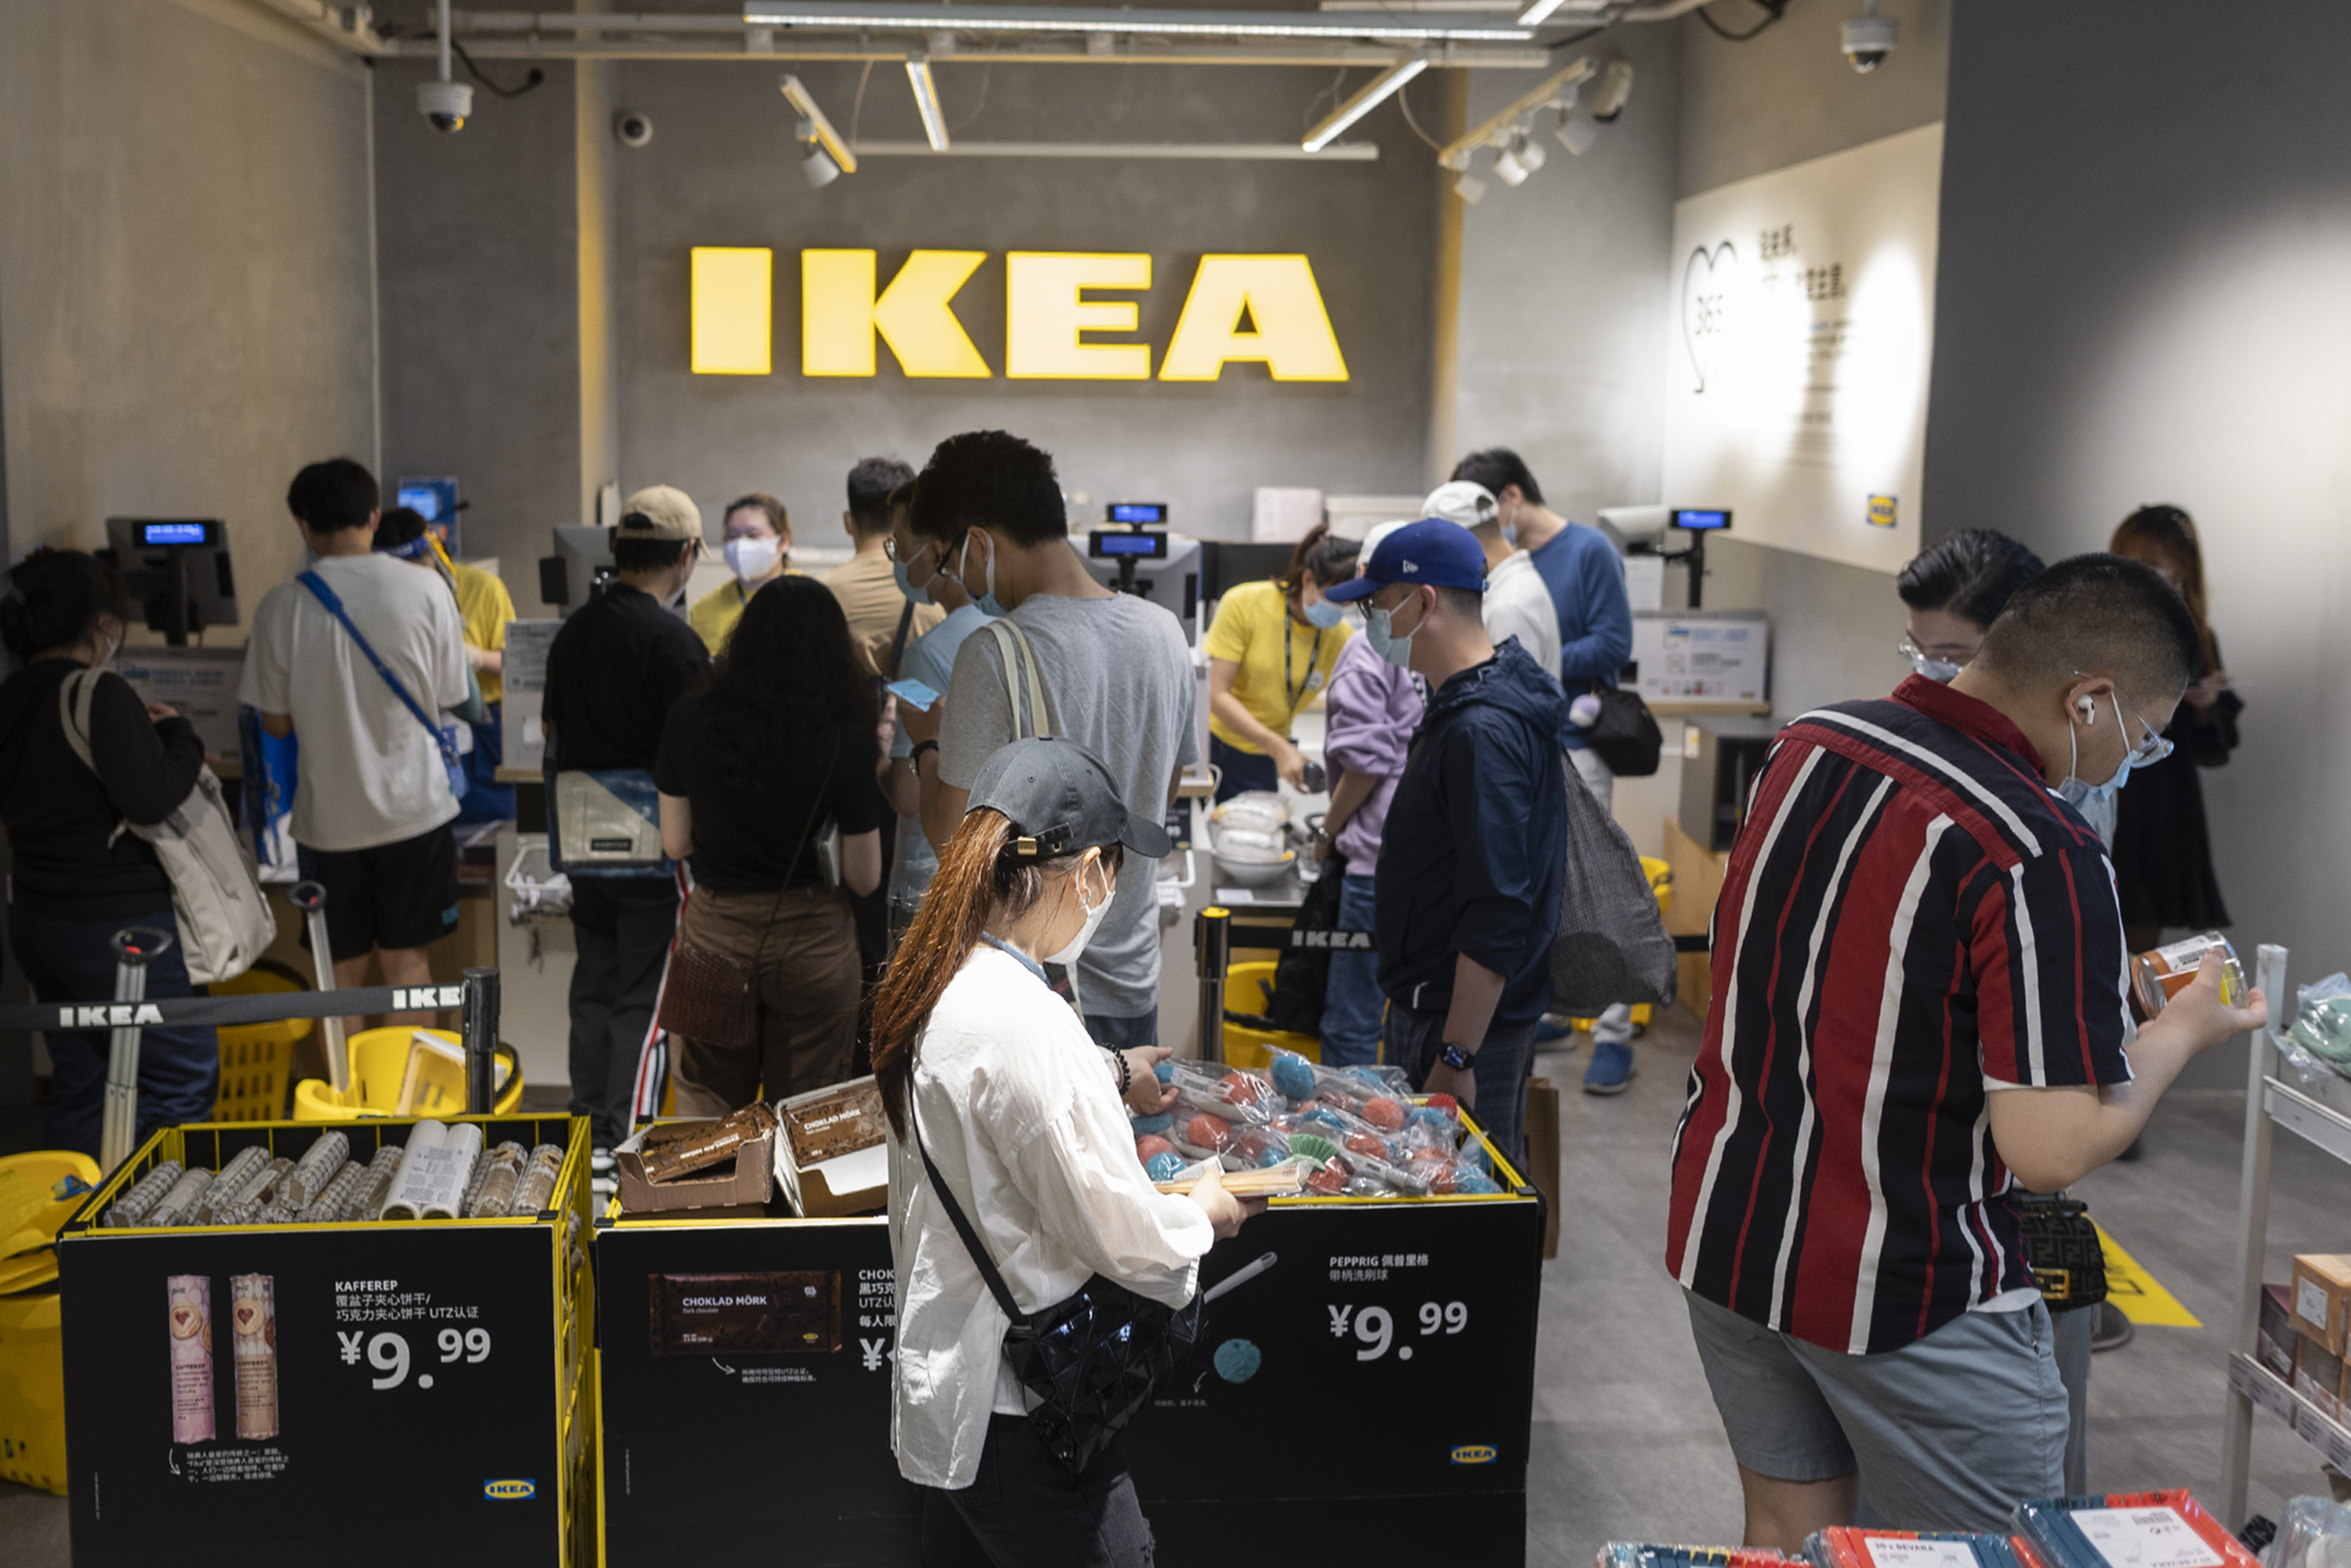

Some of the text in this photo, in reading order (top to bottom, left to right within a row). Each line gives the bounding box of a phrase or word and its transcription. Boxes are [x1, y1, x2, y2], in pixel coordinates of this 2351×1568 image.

[691, 247, 1349, 381] IKEA
[1291, 930, 1371, 948] IKEA
[60, 1004, 164, 1027] IKEA
[804, 1115, 839, 1131] CHOKLAD
[1330, 1253, 1429, 1267] PEPPRIG 佩普里格
[1329, 1269, 1388, 1282] 带柄洗刷球
[335, 1280, 398, 1292] KAFFEREP
[335, 1293, 431, 1307] 覆盆子夹心饼干/
[683, 1295, 767, 1307] CHOKLAD MÖRK
[336, 1305, 479, 1322] 巧克力夹心饼干 UTZ认证
[1328, 1301, 1468, 1362] ¥9.99
[336, 1327, 491, 1389] ¥9.99
[1896, 1543, 1936, 1552] BEVARA
